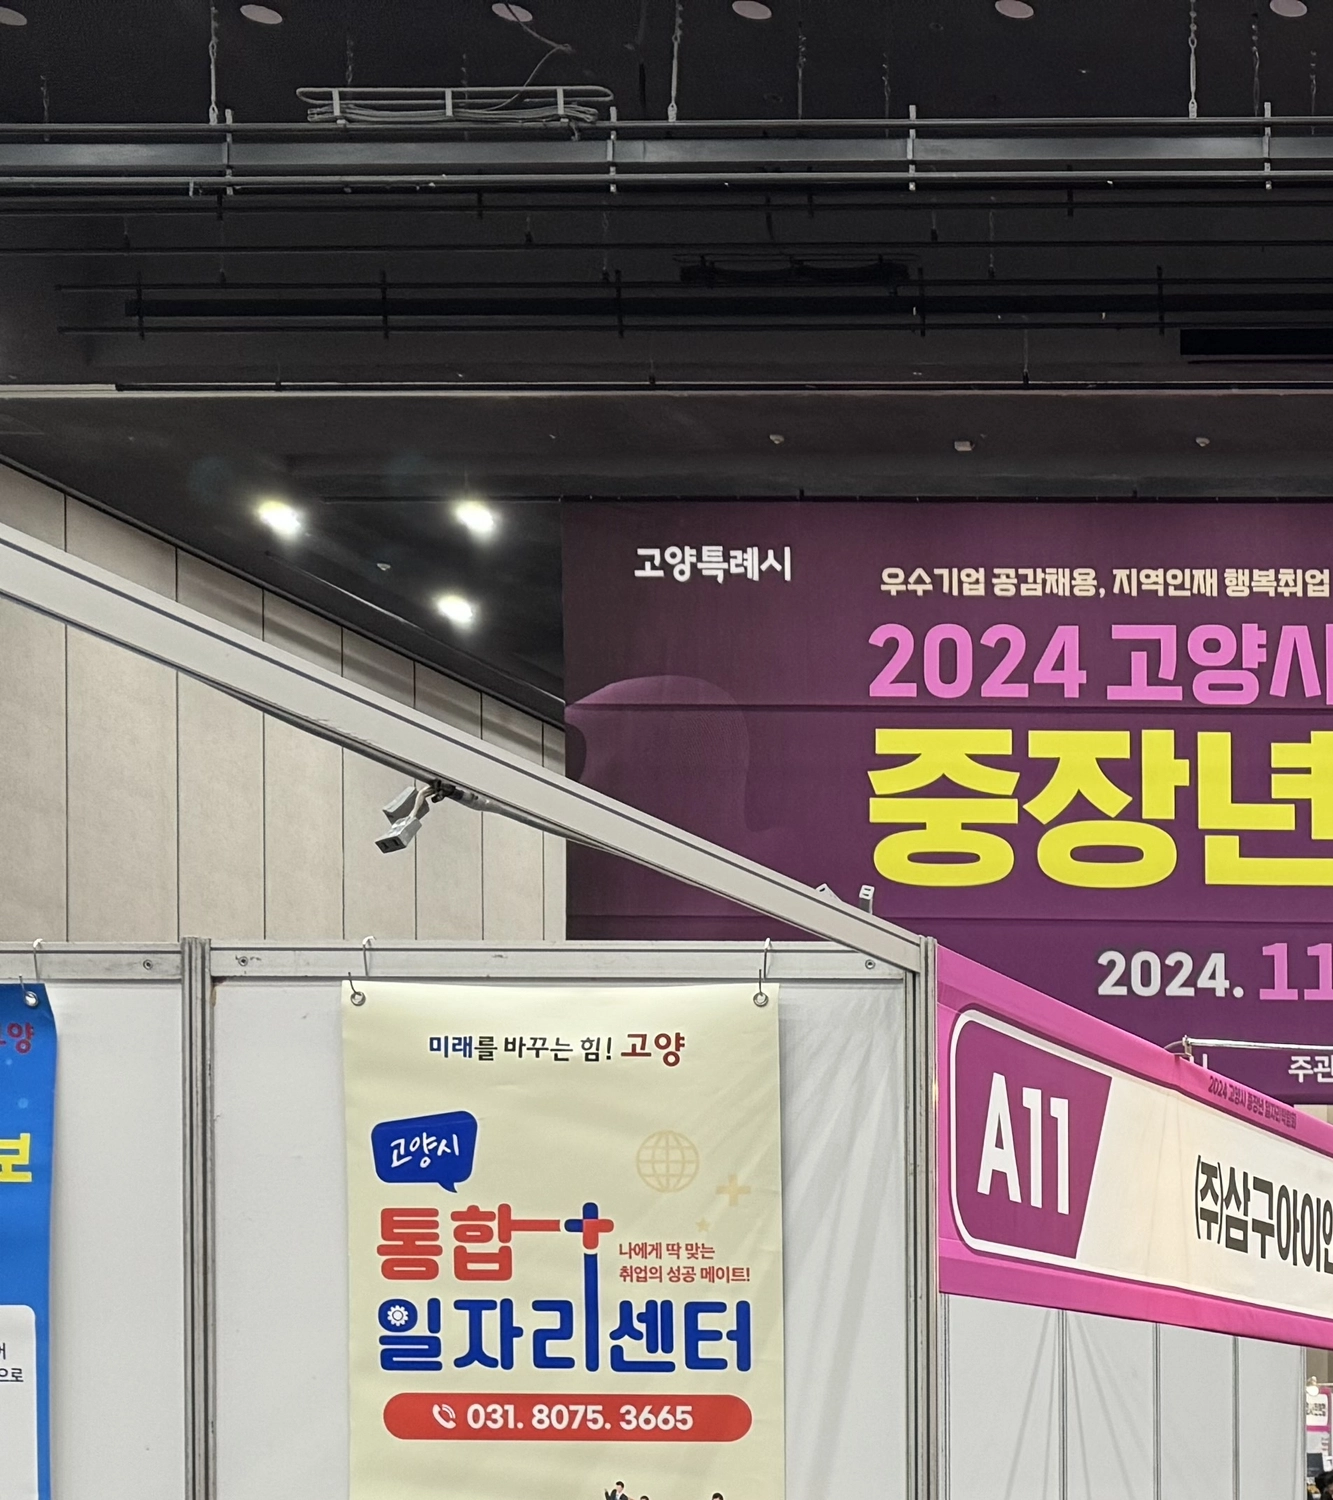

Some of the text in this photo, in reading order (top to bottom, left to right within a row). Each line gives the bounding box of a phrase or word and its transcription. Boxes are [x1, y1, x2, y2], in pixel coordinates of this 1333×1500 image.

[635, 546, 791, 583] 고양특례시
[881, 568, 1329, 598] 우수기업 공감채용, 지역인재 행복취업
[869, 624, 1086, 698] 2024
[1098, 951, 1243, 998] 2024.
[0, 1022, 34, 1054] 양
[430, 1033, 685, 1066] 미래를 바꾸는 힘! 고양
[389, 1133, 460, 1171] 고양시
[977, 1072, 1070, 1215] A11
[376, 1204, 513, 1282] 통합
[619, 1242, 715, 1259] 나에게 딱 맞는
[620, 1266, 749, 1283] 취업의 성공 메이트!
[377, 1298, 752, 1374] 일자리센터
[467, 1404, 693, 1430] 031. 8075. 3665
